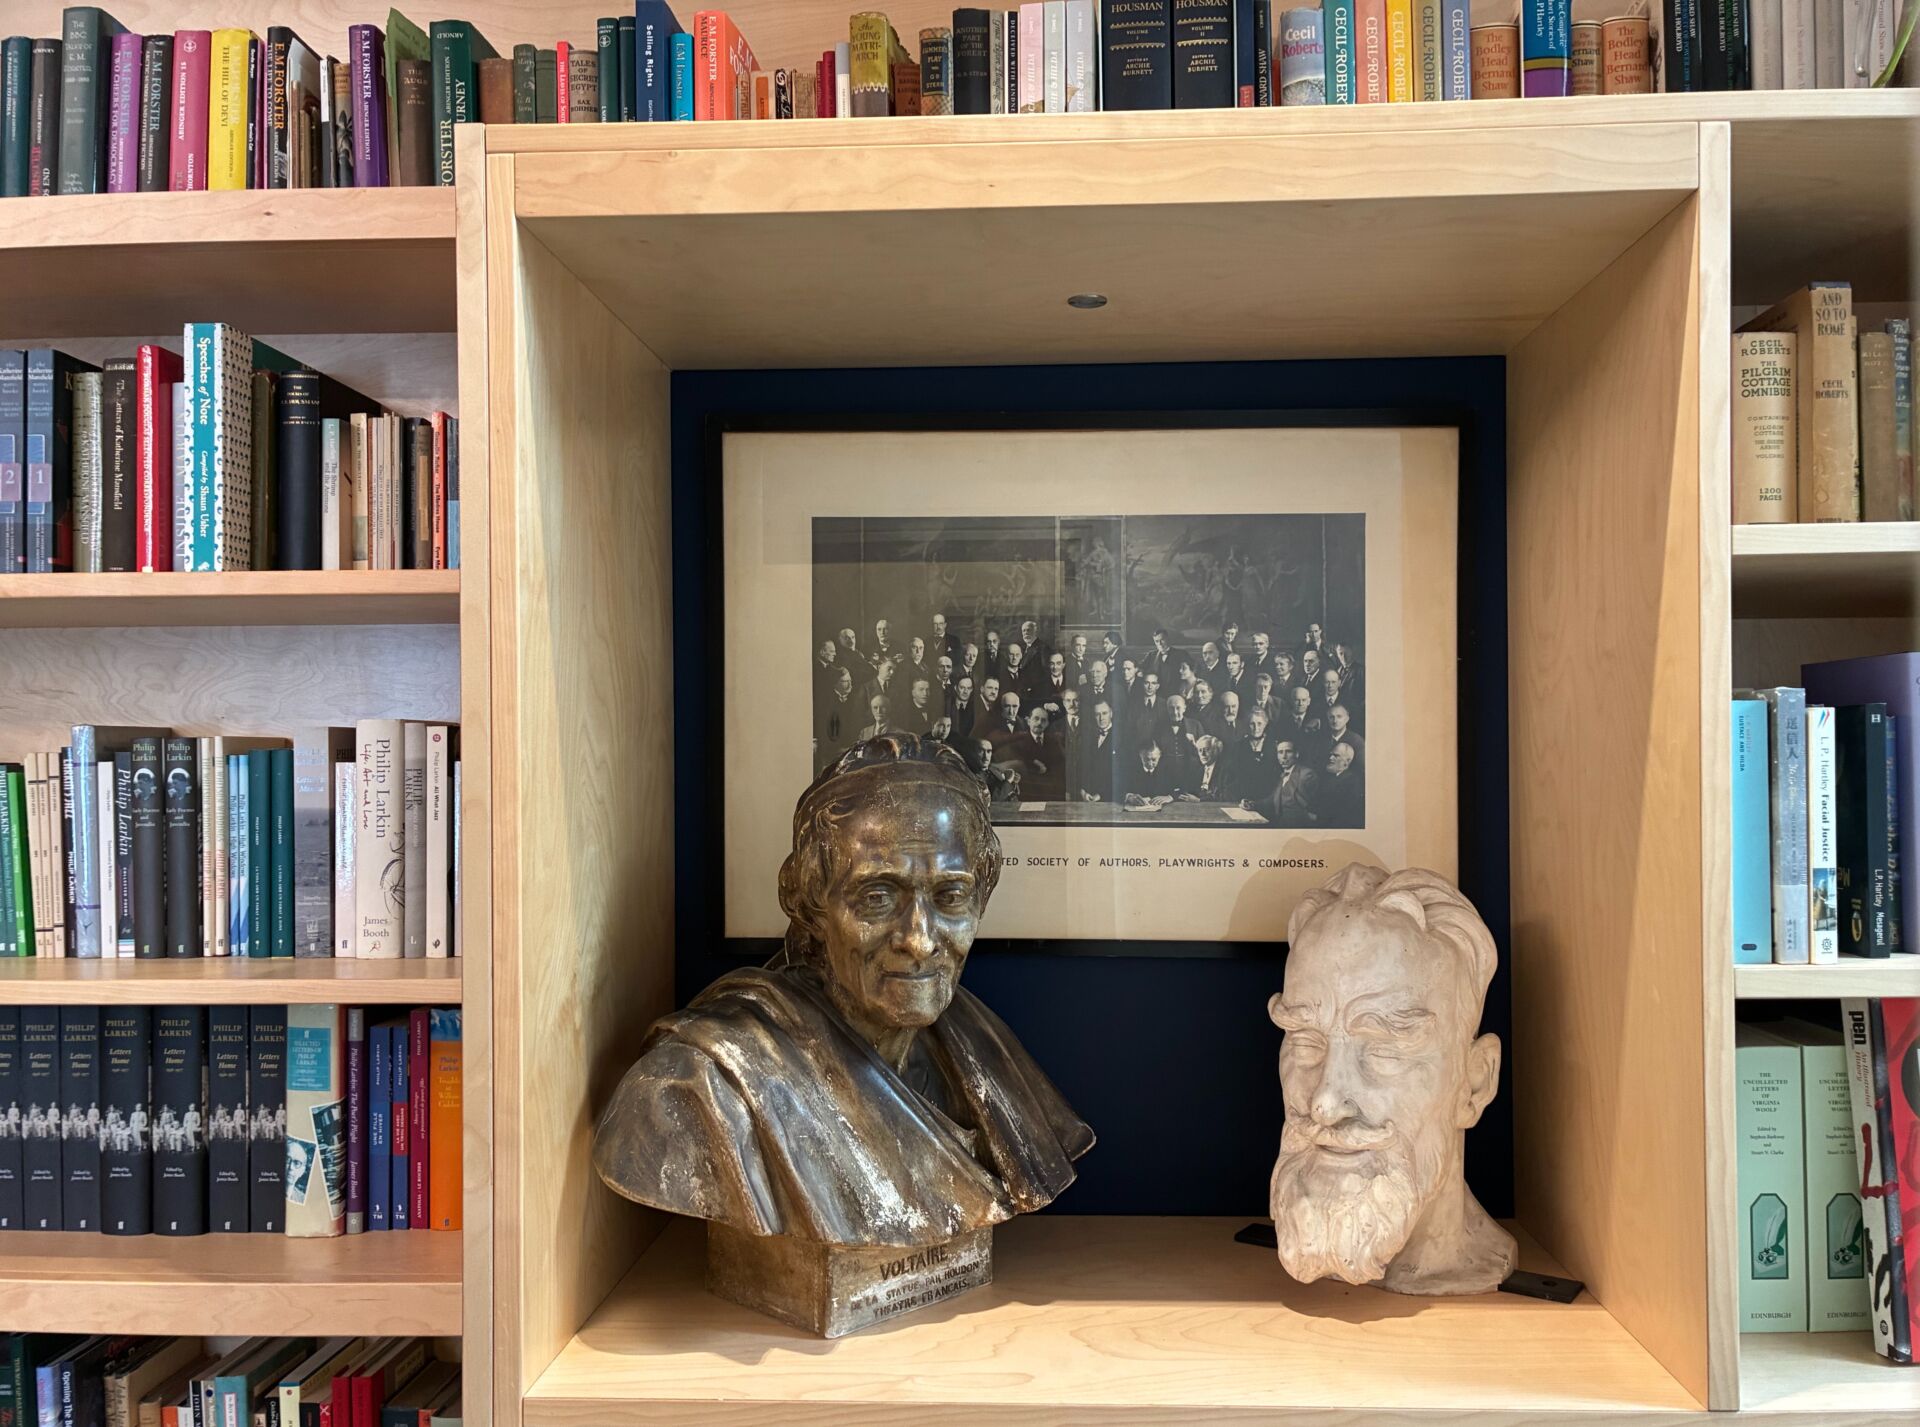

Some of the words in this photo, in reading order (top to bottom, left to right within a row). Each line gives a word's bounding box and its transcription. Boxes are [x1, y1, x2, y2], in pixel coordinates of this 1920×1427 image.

[1111, 2, 1163, 13] HOUSMAN
[1176, 0, 1228, 9] HOUSMAN
[1335, 7, 1347, 49] CECIL
[1392, 11, 1404, 52] CECIL
[1422, 5, 1434, 46] CECIL
[1452, 9, 1464, 48] CECIL
[1557, 11, 1566, 47] Complete
[1617, 26, 1635, 36] The
[1688, 17, 1697, 38] SHAW
[645, 25, 654, 55] Selling
[851, 32, 881, 41] YOUNG
[1285, 26, 1316, 41] Cecil
[1366, 17, 1378, 59] CECIL
[1485, 33, 1503, 43] The
[1674, 18, 1682, 52] HOLROYD
[851, 43, 882, 51] MATRI-
[1475, 44, 1512, 57] Bodley
[1608, 38, 1645, 50] Bodley
[709, 38, 717, 81] FORSTER
[856, 52, 879, 61] ARCH
[1259, 48, 1268, 74] SHAW
[1481, 56, 1508, 66] Head
[1614, 50, 1641, 61] Head
[362, 52, 372, 98] FORSTER
[645, 59, 654, 87] Rights
[1188, 65, 1218, 73] BURNETT
[1474, 70, 1516, 80] Bernard
[1606, 63, 1649, 74] Bernard
[570, 74, 598, 82] SECRET
[1615, 75, 1642, 86] Shaw
[571, 83, 597, 92] EGYPT
[1482, 81, 1510, 91] Shaw
[222, 89, 229, 100] OF
[149, 78, 161, 131] FORSTER
[220, 105, 228, 127] DEVI
[178, 106, 186, 141] ABINGER
[109, 131, 118, 185] DEMOCRACY
[1821, 292, 1842, 305] AND
[1815, 308, 1831, 321] SO
[1832, 308, 1847, 321] TO
[1817, 323, 1846, 336] ROME
[1750, 340, 1783, 348] CECIL
[1741, 348, 1791, 356] ROBERTS
[197, 337, 211, 384] Speeches
[1741, 368, 1791, 378] PILGRIM
[1741, 378, 1791, 388] COTTAGE
[1822, 379, 1843, 389] CECIL
[198, 386, 210, 396] of
[1741, 388, 1791, 398] OMNIBUS
[1815, 390, 1849, 399] ROBERTS
[199, 398, 210, 425] Note
[114, 435, 125, 472] Katherine
[5, 470, 15, 484] 2
[36, 470, 44, 484] 1
[113, 473, 124, 510] Mansfield
[200, 486, 210, 513] Shaun
[200, 514, 210, 538] Usher
[133, 743, 156, 754] Philip
[167, 743, 191, 754] Philip
[132, 753, 157, 761] Larkin
[166, 753, 192, 761] Larkin
[376, 738, 391, 784] Philip
[1819, 760, 1829, 792] Hartley
[117, 769, 131, 809] Philip
[405, 768, 414, 811] LARKIN
[413, 768, 423, 806] PHILIP
[376, 790, 391, 839] Larkin
[1821, 794, 1830, 824] Facial
[118, 813, 132, 856] Larkin
[1821, 826, 1830, 863] Justice
[1027, 857, 1069, 867] SOCIETY
[1077, 858, 1090, 867] OF
[1099, 858, 1151, 868] AUTHORS,
[1158, 858, 1235, 868] PLAYWRIGHTS
[1242, 859, 1250, 868] &
[1258, 859, 1328, 868] COMPOSERS.
[68, 876, 76, 904] LARKIN
[1874, 882, 1883, 908] Hartley
[363, 916, 388, 926] James
[363, 929, 390, 938] Booth
[1875, 911, 1886, 946] Mesagerul
[105, 1029, 138, 1037] LARKIN
[159, 1029, 192, 1037] LARKIN
[1849, 1010, 1866, 1045] pen
[253, 1034, 285, 1042] LARKIN
[109, 1048, 132, 1056] Letters
[163, 1048, 186, 1056] Letters
[258, 1053, 280, 1061] Letters
[260, 1062, 278, 1070] Home
[1855, 1051, 1863, 1082] History
[1862, 1064, 1874, 1108] Illustrated
[350, 1092, 358, 1105] The
[349, 1125, 358, 1144] Plight
[349, 1161, 358, 1180] James
[350, 1180, 358, 1199] Booth
[880, 1245, 948, 1280] VOLTAIRE
[851, 1301, 862, 1311] DE
[866, 1295, 878, 1306] LA
[886, 1280, 919, 1300] STATUE
[925, 1276, 941, 1286] PAR
[944, 1261, 979, 1279] HOUDON
[63, 1372, 71, 1405] Opening
[64, 1406, 73, 1422] The
